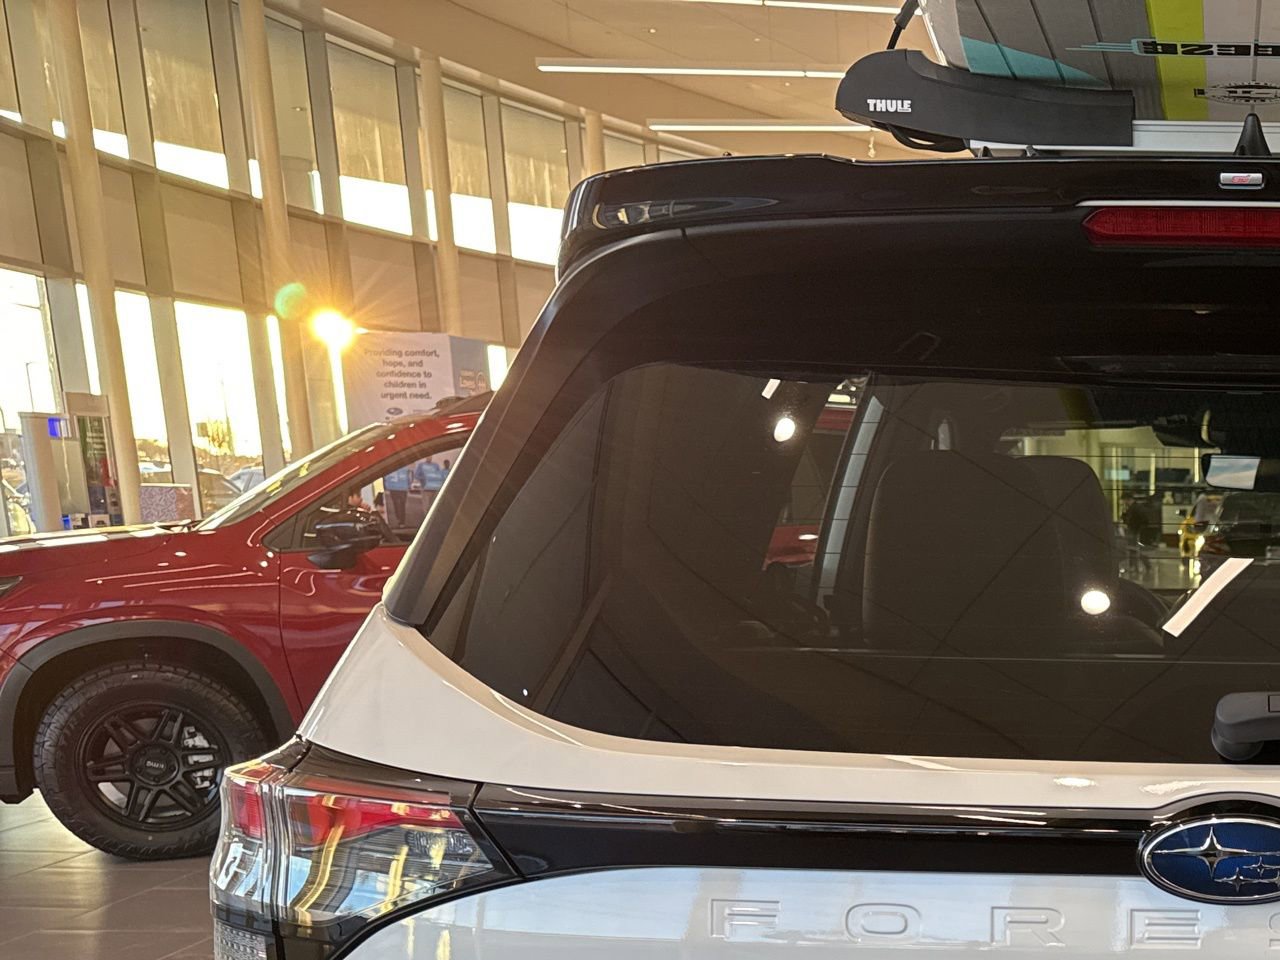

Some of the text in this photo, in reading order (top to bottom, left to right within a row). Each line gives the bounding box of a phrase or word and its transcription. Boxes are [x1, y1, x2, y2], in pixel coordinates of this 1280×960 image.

[867, 99, 912, 113] THULE
[364, 348, 440, 358] Providing comfort,
[382, 360, 424, 368] hope, and
[376, 370, 433, 379] confidence to
[384, 380, 427, 389] children in
[380, 391, 433, 400] urgent need.
